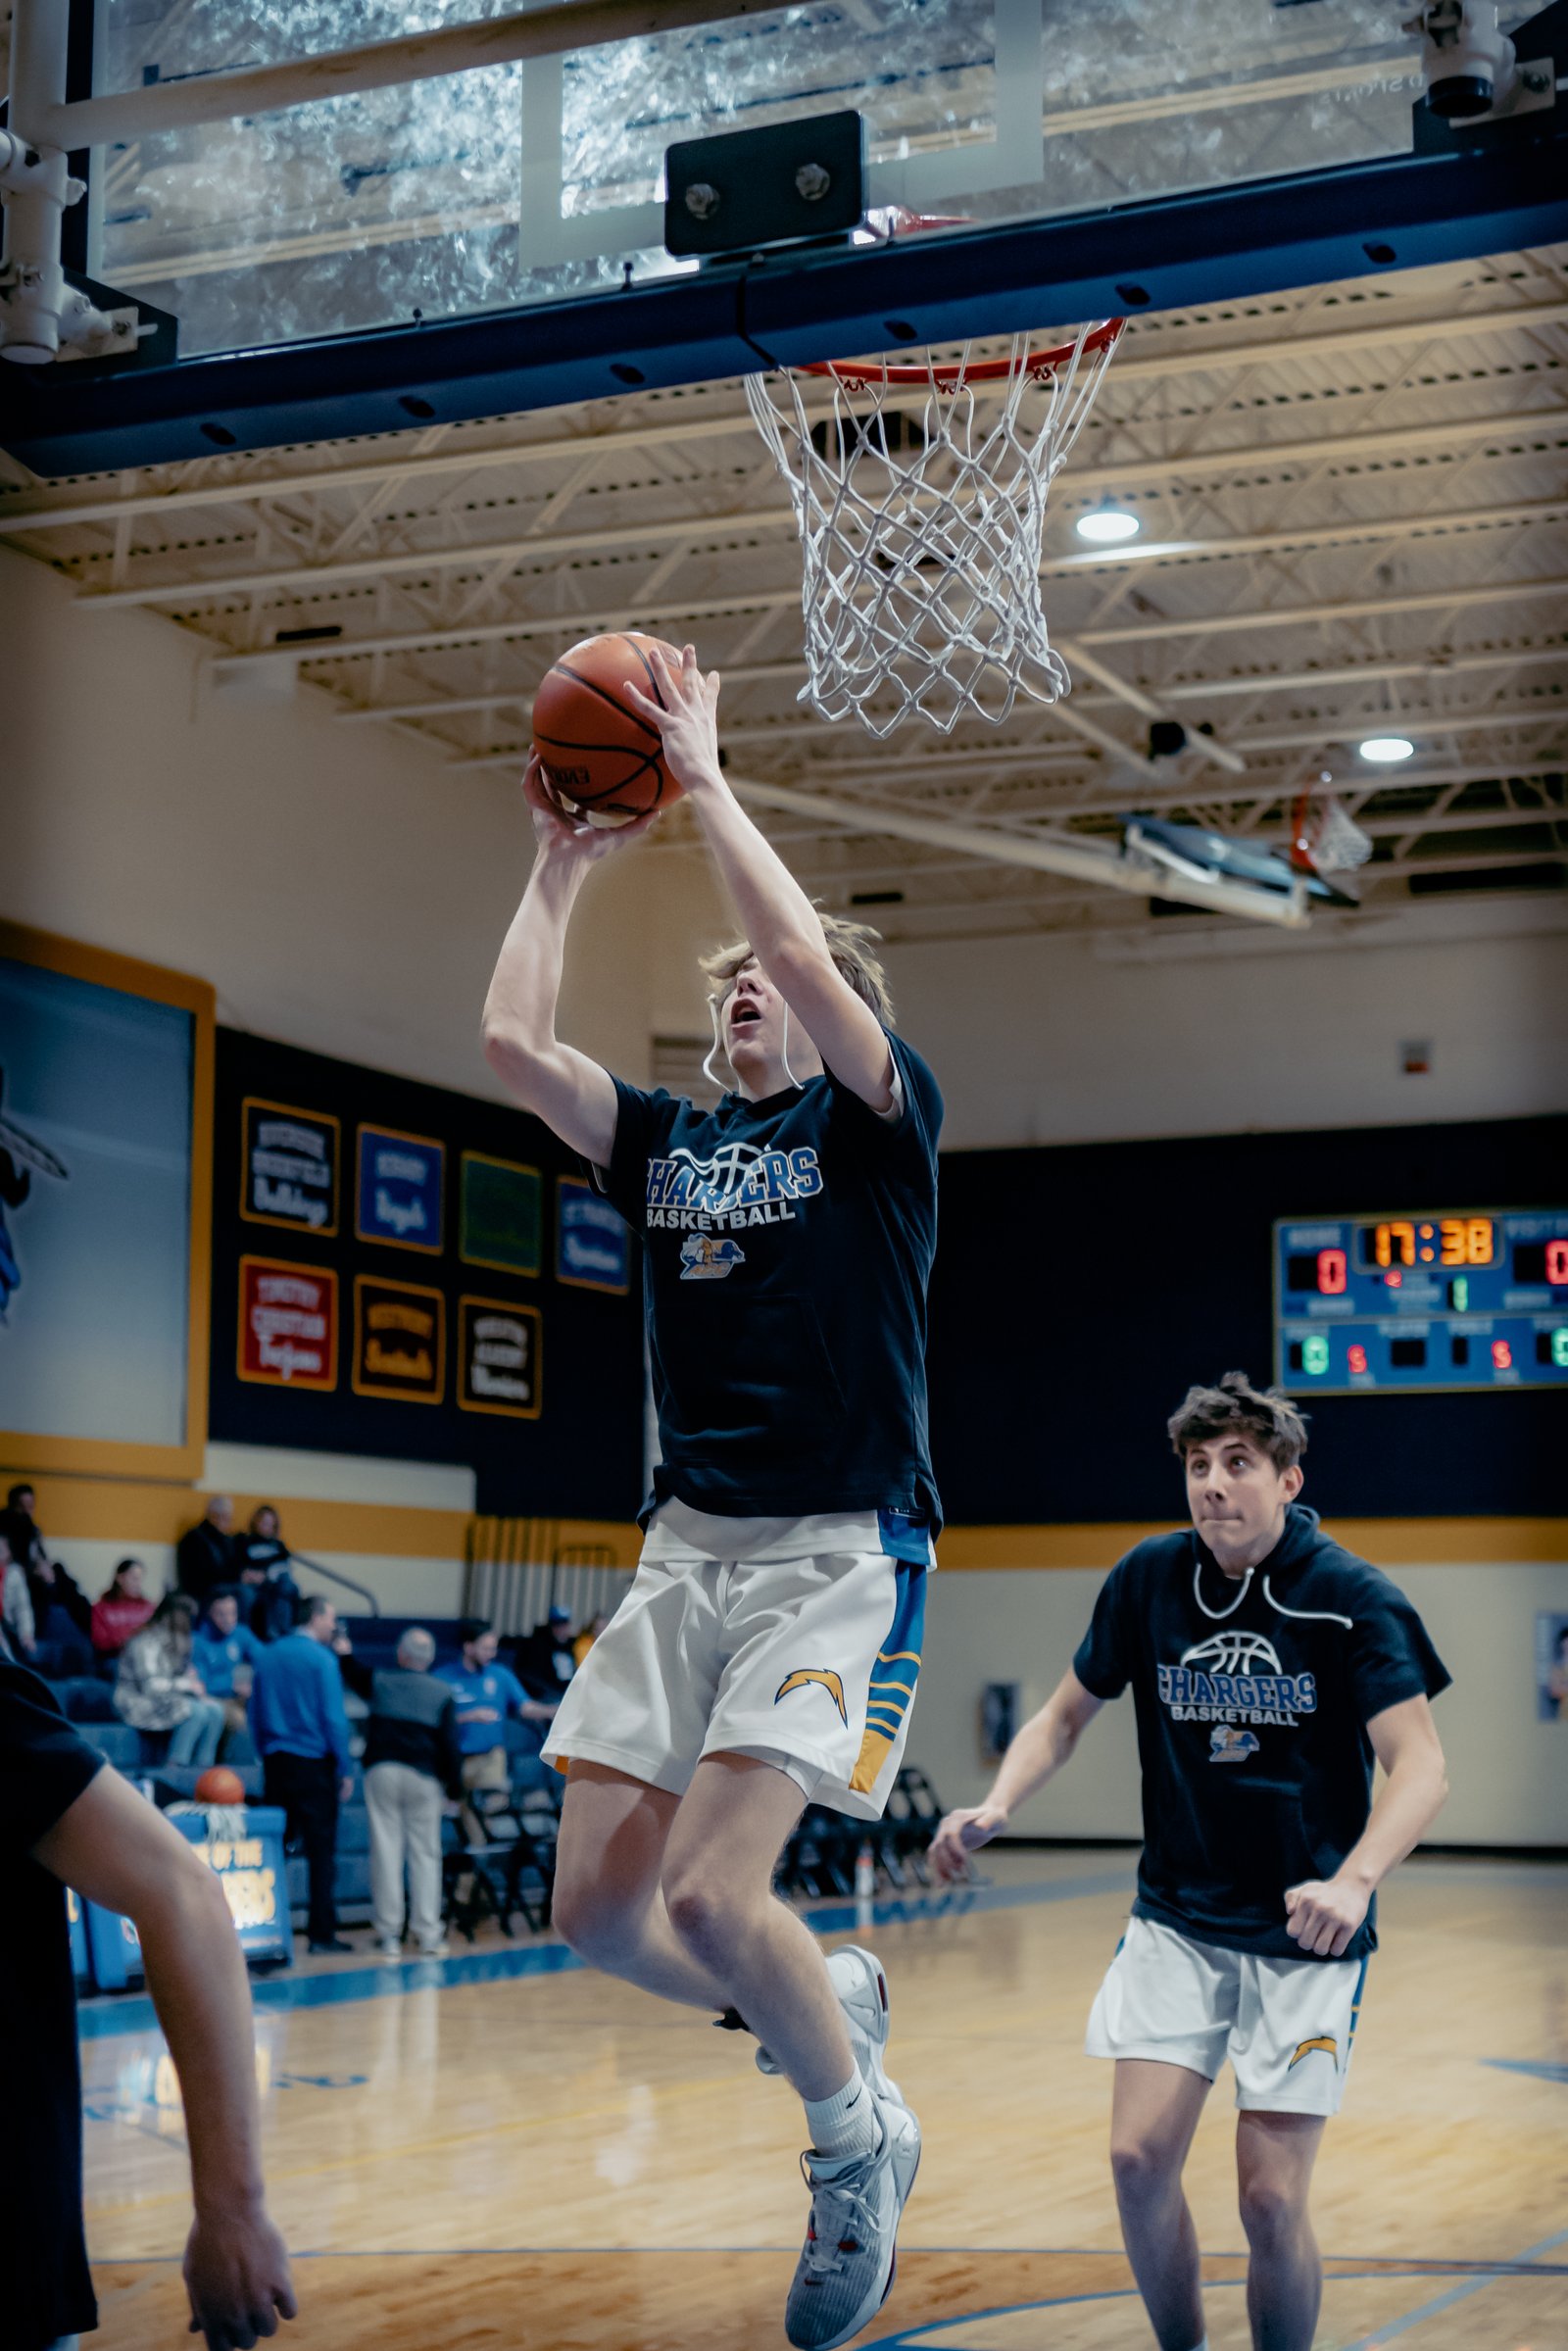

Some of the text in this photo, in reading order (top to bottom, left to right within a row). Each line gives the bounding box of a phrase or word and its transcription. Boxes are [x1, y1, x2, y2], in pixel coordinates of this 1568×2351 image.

[1375, 1218, 1494, 1267] 17:38
[1317, 1249, 1347, 1294] 0
[1157, 1664, 1318, 1714] CHARGERS
[1171, 1705, 1298, 1727] BASKETBALL
